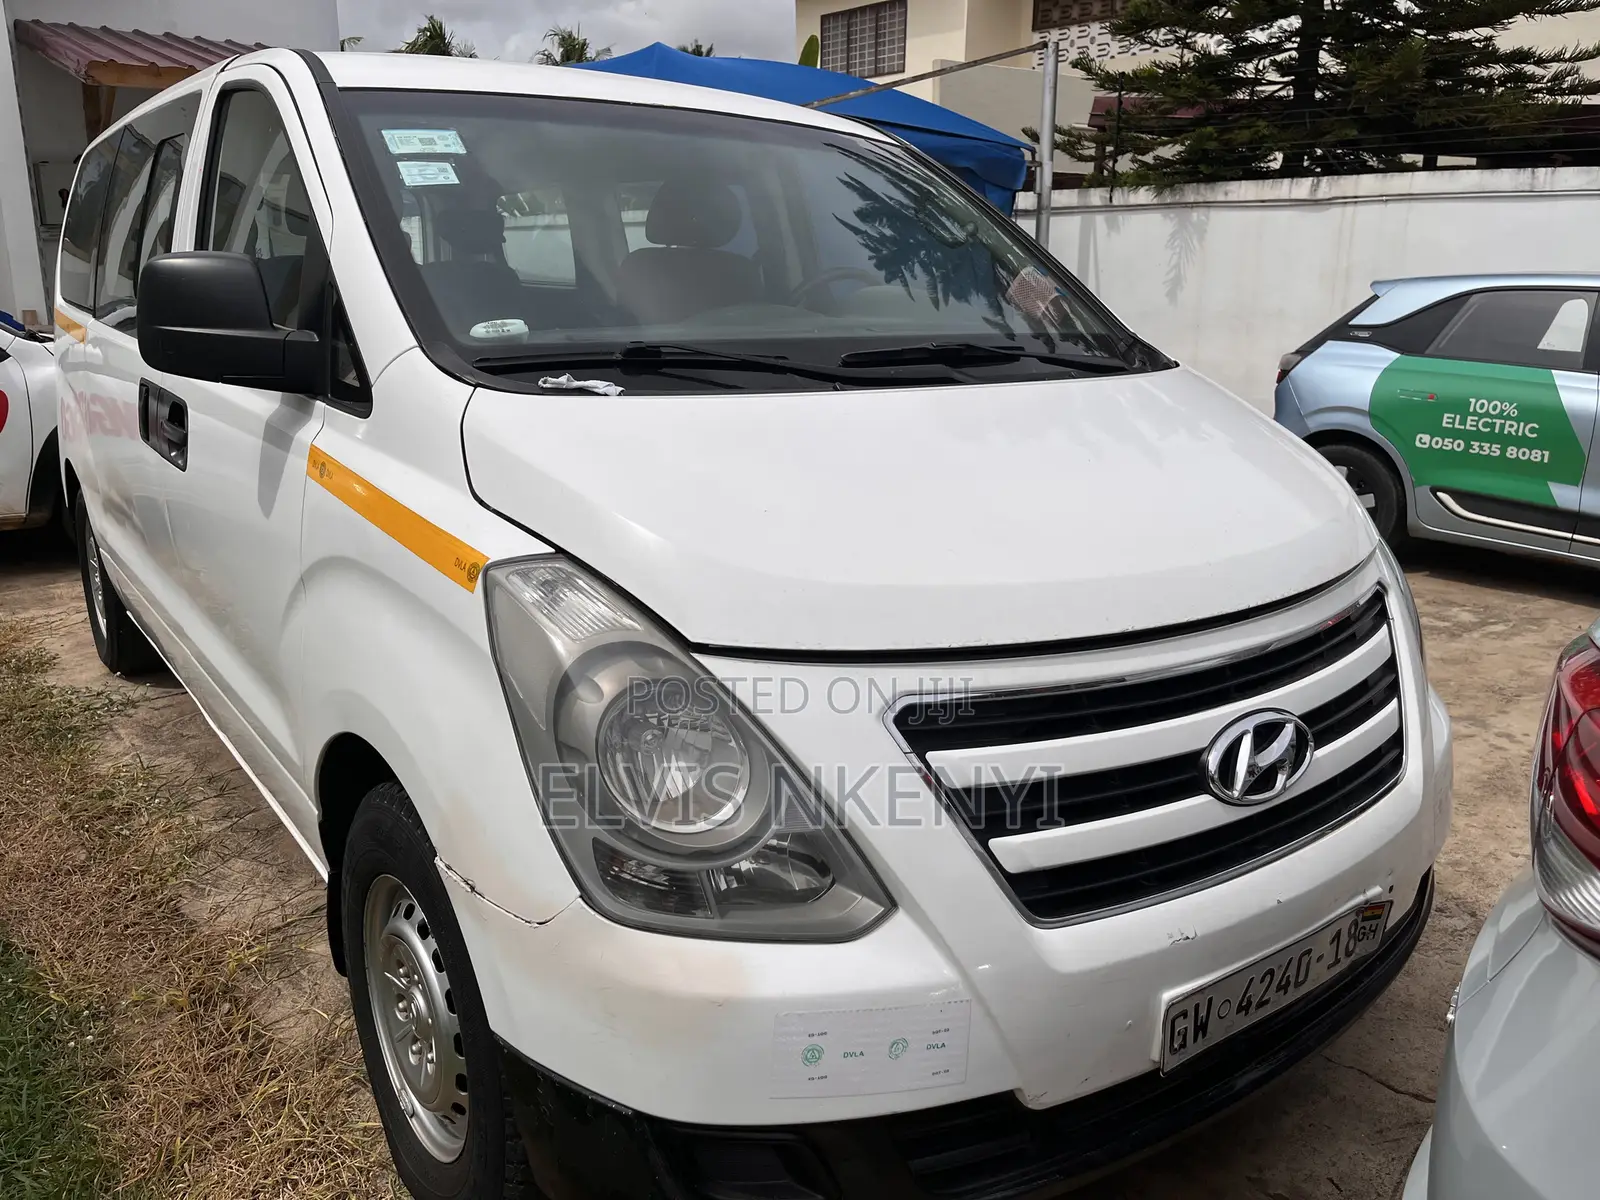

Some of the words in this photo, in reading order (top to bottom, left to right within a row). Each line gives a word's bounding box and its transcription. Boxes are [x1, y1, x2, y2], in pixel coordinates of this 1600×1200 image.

[1468, 398, 1518, 417] 100%
[1441, 413, 1540, 438] ELECTRIC
[1431, 437, 1465, 452] 050
[1469, 441, 1501, 457] 335
[1505, 446, 1550, 463] 8081
[454, 557, 467, 573] DVLA
[1357, 922, 1380, 943] GH
[1169, 995, 1214, 1055] GW
[843, 1050, 865, 1059] DVLA
[925, 1042, 947, 1051] DVLA
